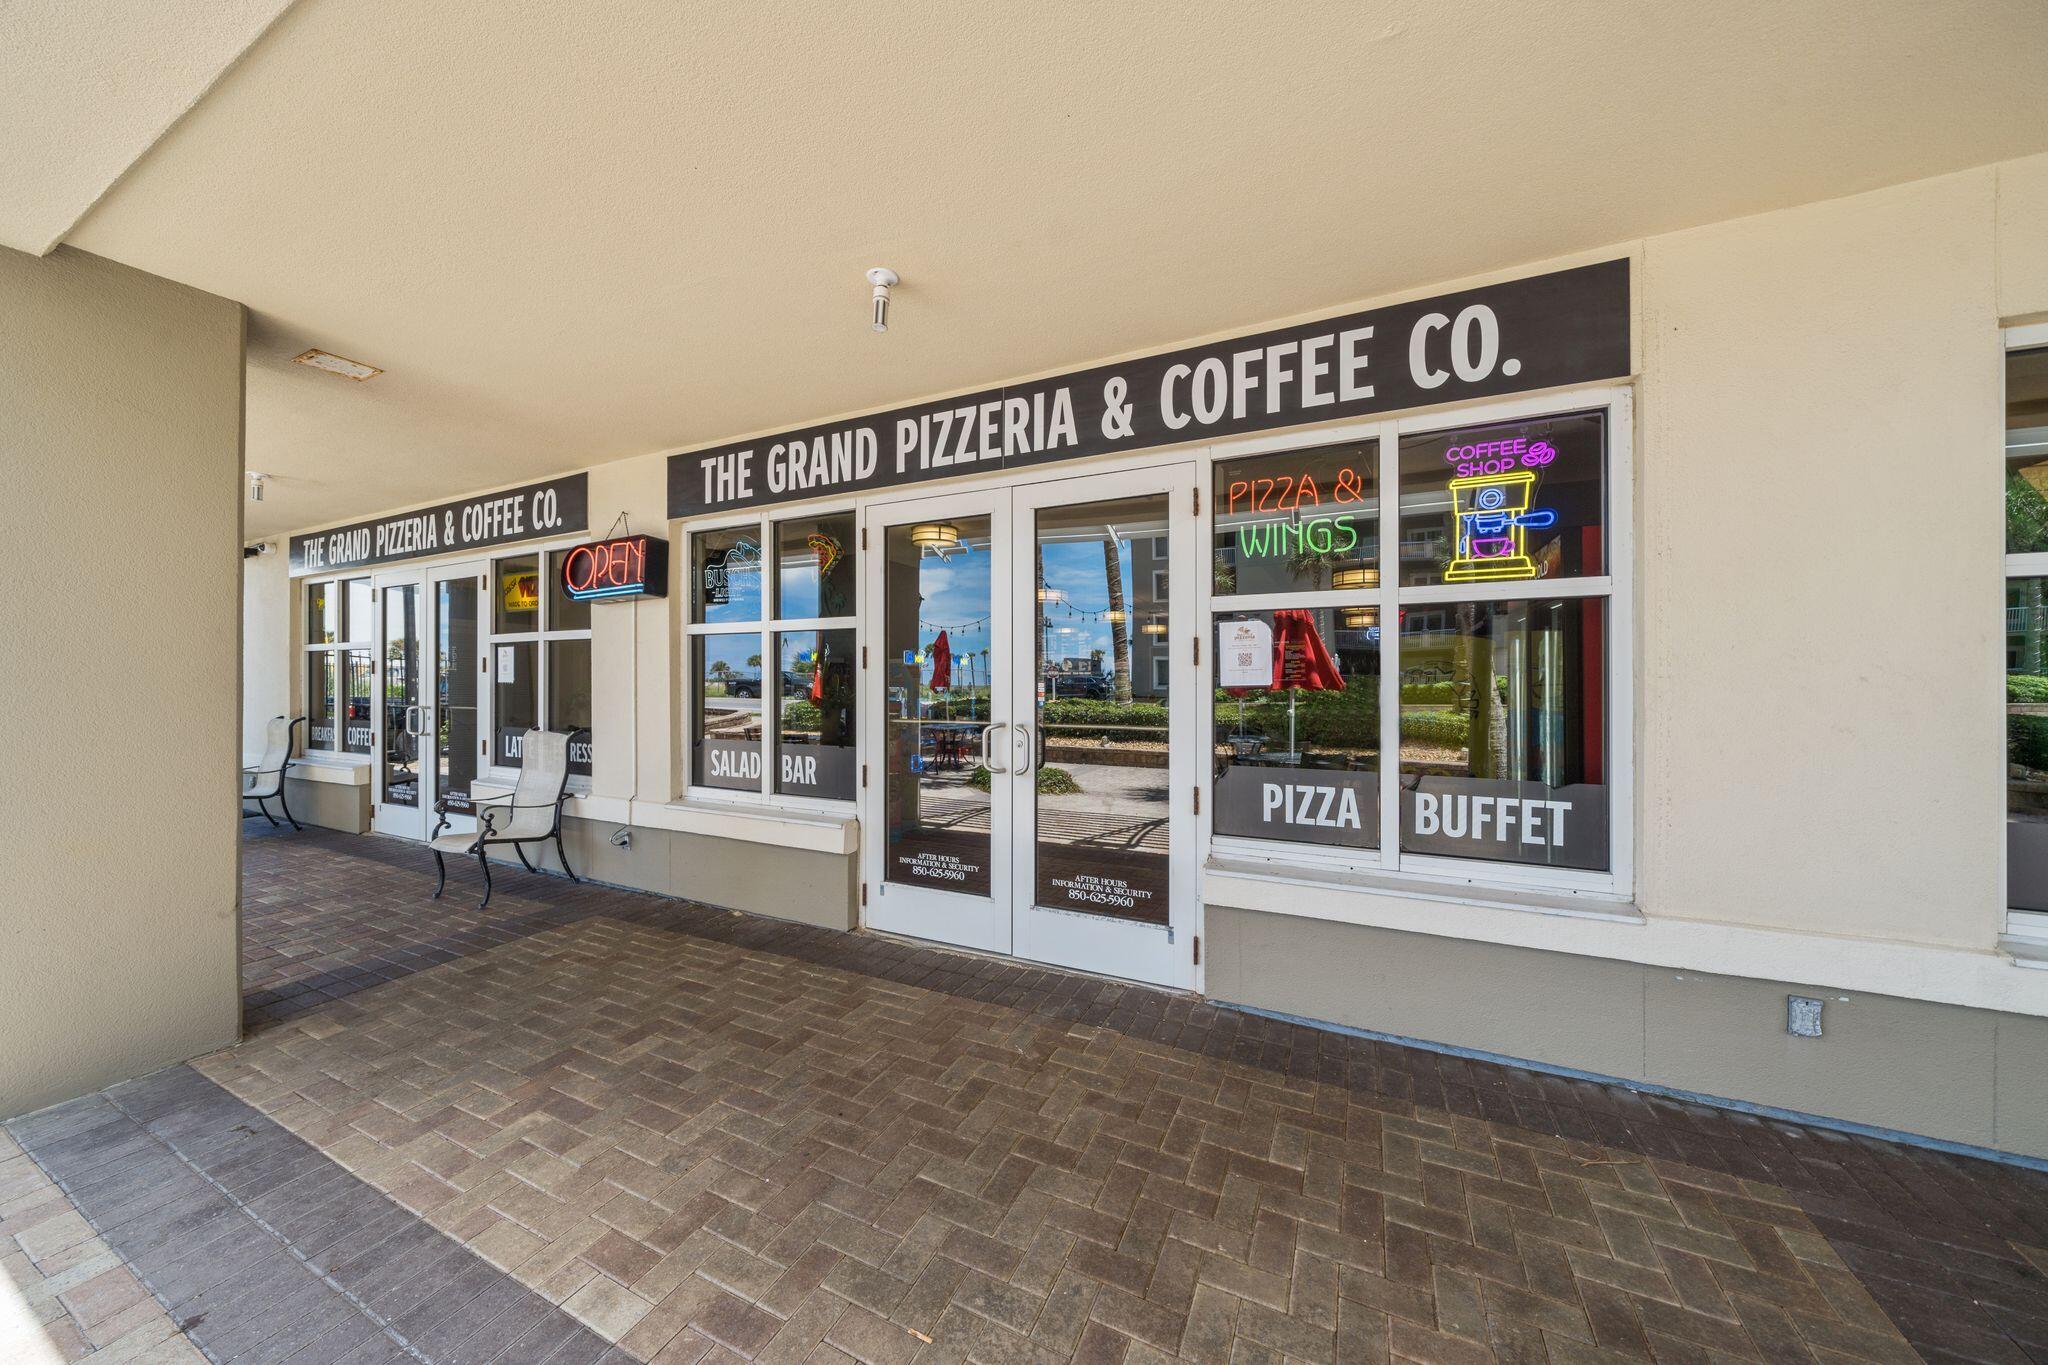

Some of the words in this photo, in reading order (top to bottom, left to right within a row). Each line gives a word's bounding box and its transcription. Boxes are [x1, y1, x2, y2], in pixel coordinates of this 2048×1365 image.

[701, 450, 754, 504] THE
[767, 428, 878, 494] GRAND
[896, 386, 1079, 473] PIZZERIA
[1101, 376, 1134, 440] &
[1160, 326, 1375, 430] COFFEE
[1408, 304, 1522, 390] CO.
[1446, 438, 1527, 462] COFFEE
[1456, 457, 1516, 478] SHOP
[1229, 473, 1320, 516] PIZZA
[1334, 468, 1364, 504] &
[303, 536, 325, 569] THE
[328, 527, 371, 565] GRAND
[375, 514, 437, 557] PIZZERIA
[443, 510, 455, 546] &
[461, 495, 524, 543] COFFEE
[532, 488, 562, 530] CO.
[1240, 515, 1357, 558] WINGS
[565, 539, 646, 591] OPEN
[710, 749, 761, 779] SALAD
[782, 754, 817, 785] BAR
[1263, 783, 1361, 829] PIZZA
[1415, 792, 1572, 846] BUFFET
[899, 857, 941, 868] INFORMATION
[948, 863, 980, 873] SECURITY
[917, 853, 938, 861] AFTER
[938, 855, 960, 864] HOURS
[912, 866, 965, 881] 850-625-5960
[1075, 875, 1100, 885] AFTER
[1101, 878, 1128, 888] HOURS
[1052, 878, 1104, 893] INFORMATION
[1105, 886, 1112, 894] &
[1113, 887, 1153, 899] SECURITY
[1068, 888, 1134, 908] 850-625-5960
